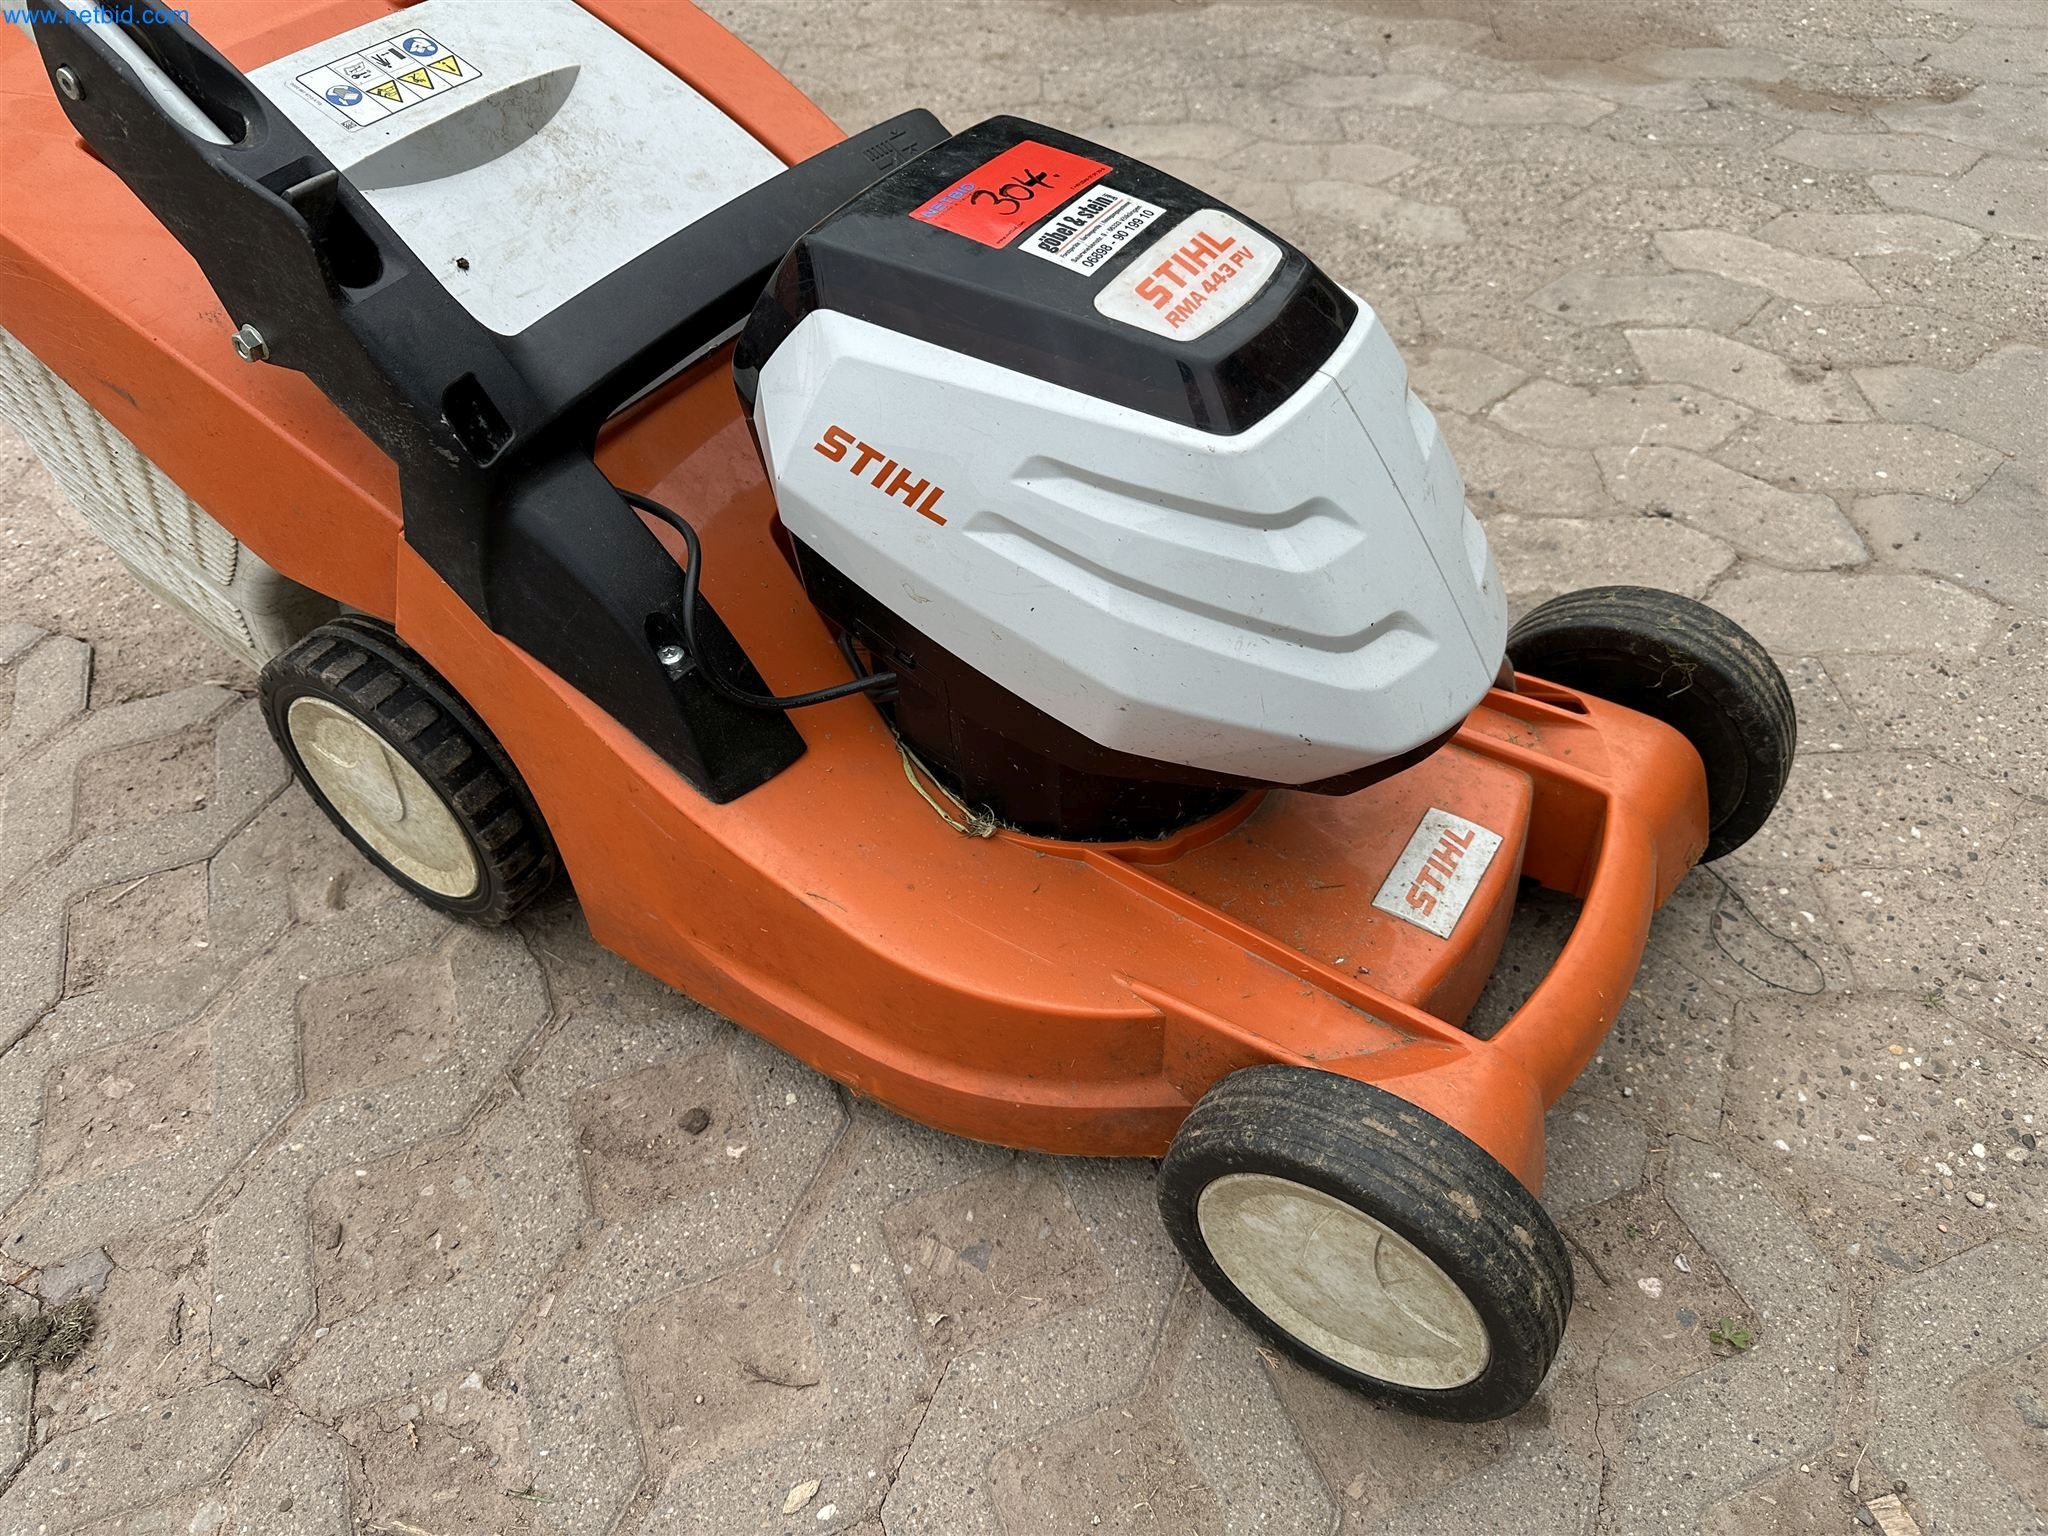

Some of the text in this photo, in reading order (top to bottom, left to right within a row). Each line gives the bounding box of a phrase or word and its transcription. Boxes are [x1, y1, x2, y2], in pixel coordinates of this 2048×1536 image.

[921, 182, 976, 218] NETBID
[1038, 223, 1077, 254] göbel
[1063, 214, 1087, 227] &
[1078, 196, 1113, 219] stein
[1081, 244, 1112, 268] 06898
[1112, 230, 1129, 241] 90
[1124, 218, 1144, 231] 199
[1138, 209, 1155, 219] 10
[1135, 231, 1236, 310] STIHL
[1164, 245, 1255, 329] RMA 443 PV
[814, 425, 948, 526] STIHL
[1405, 828, 1476, 917] STIHL
